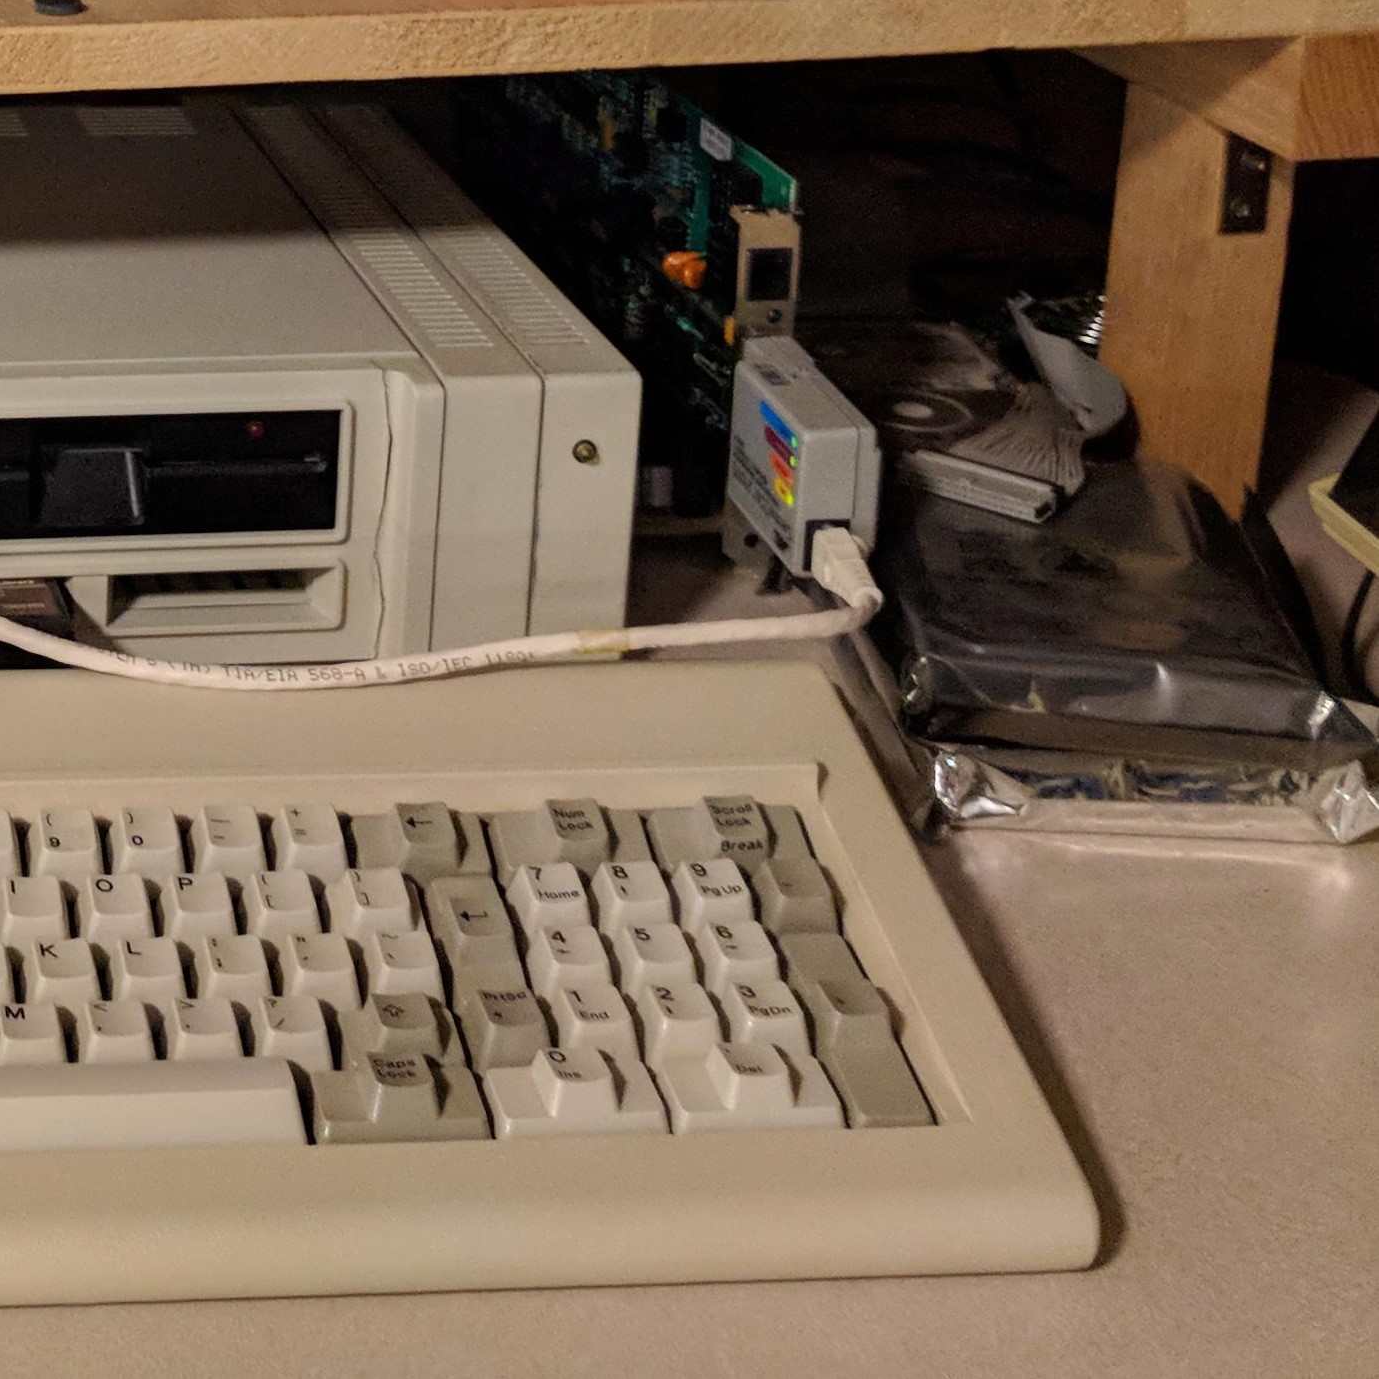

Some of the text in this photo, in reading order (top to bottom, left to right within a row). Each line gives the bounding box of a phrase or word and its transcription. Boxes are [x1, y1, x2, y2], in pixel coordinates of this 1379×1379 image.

[308, 666, 366, 682] 568-A
[398, 655, 472, 677] ISO/IEC
[553, 807, 585, 819] Num
[710, 803, 754, 816] Scroll
[558, 819, 594, 831] Lock
[49, 836, 60, 848] 9
[721, 838, 764, 853] Break
[528, 866, 542, 881] 7
[612, 865, 628, 879] 8
[691, 863, 707, 877] 9
[9, 879, 16, 894] I
[95, 878, 113, 893] O
[177, 876, 193, 891] P
[537, 888, 580, 901] Home
[550, 930, 566, 944] 4
[634, 928, 651, 942] 5
[717, 926, 733, 940] 6
[39, 943, 58, 958] K
[126, 940, 142, 956] L
[570, 988, 582, 1004] 1
[656, 986, 673, 1001] 2
[738, 985, 756, 999] 3
[5, 1005, 26, 1020] M
[579, 1008, 610, 1021] End
[734, 1062, 764, 1075] Del
